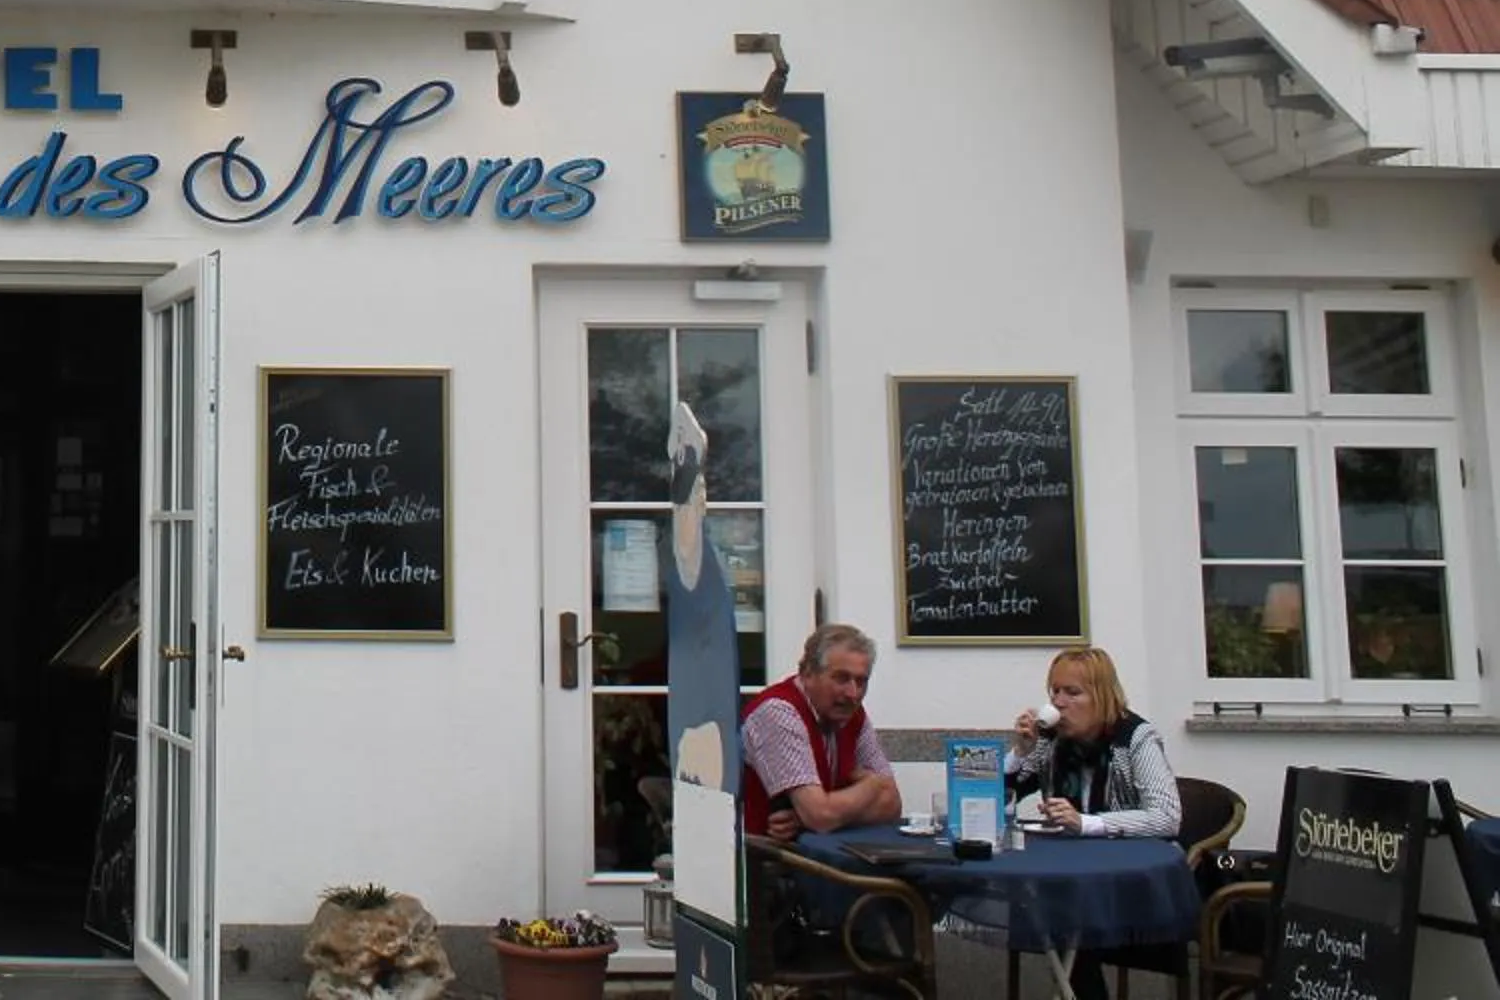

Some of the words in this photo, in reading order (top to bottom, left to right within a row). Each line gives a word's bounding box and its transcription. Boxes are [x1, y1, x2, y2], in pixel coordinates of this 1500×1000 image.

[182, 77, 607, 226] Meeres
[713, 194, 802, 226] PILSENER
[274, 423, 401, 468] Regionale
[300, 465, 360, 499] Fisch
[284, 549, 324, 590] Eis
[360, 547, 441, 588] Kuchen
[1295, 807, 1404, 873] Störtebeker
